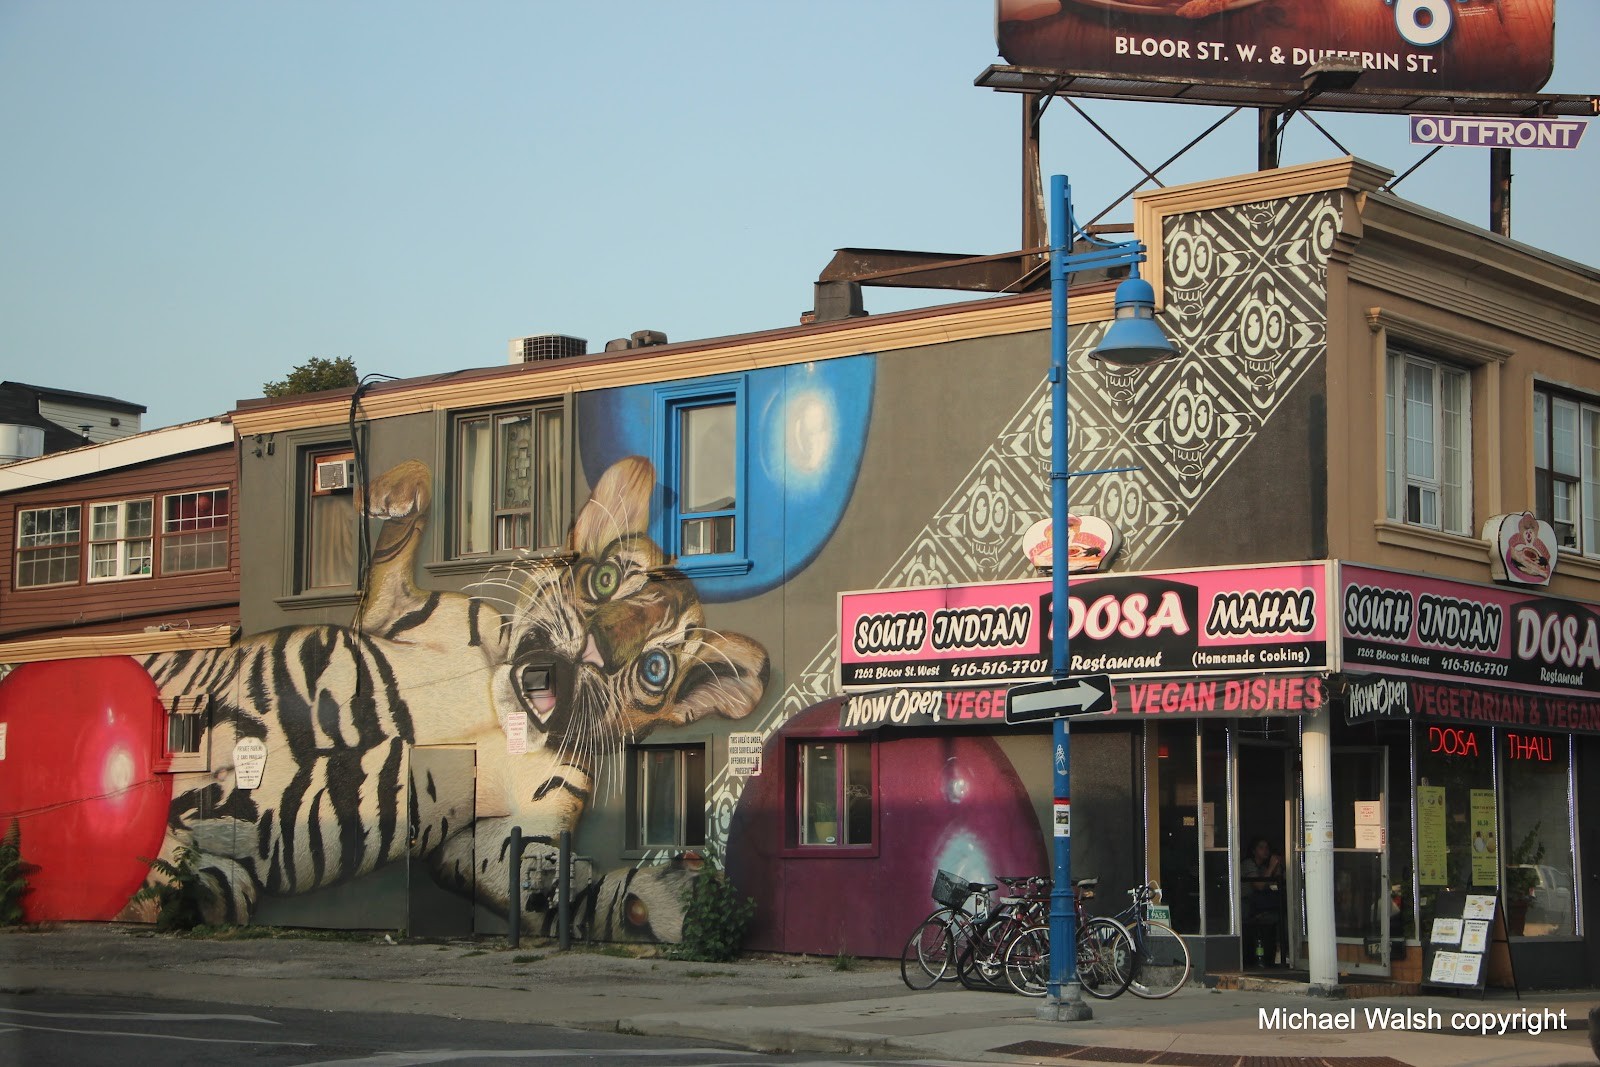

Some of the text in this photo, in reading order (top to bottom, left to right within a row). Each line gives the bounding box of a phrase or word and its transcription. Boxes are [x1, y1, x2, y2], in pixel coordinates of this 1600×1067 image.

[1115, 36, 1191, 59] BLOOR
[1197, 42, 1229, 61] ST.
[1236, 43, 1263, 63] W.
[1269, 46, 1286, 64] &
[1406, 54, 1438, 74] ST.
[1415, 118, 1579, 146] OUTFRONT
[855, 606, 1031, 654] SOUTH INDIAN
[1048, 591, 1314, 640] DOSA MAHAL
[1346, 587, 1501, 649] SOUTH INDIAN
[1517, 608, 1600, 670] DOSA
[854, 667, 874, 679] 1262
[876, 666, 903, 679] Bloor
[951, 659, 1049, 678] 416-516-7701
[1071, 651, 1162, 672] Restaurant
[1192, 647, 1311, 669] (Homemade Cooking)
[1357, 647, 1374, 659] 1262
[1376, 649, 1399, 662] Bloor
[1441, 657, 1509, 677] 416-516-7701
[1540, 667, 1584, 686] Restaurant
[890, 688, 943, 724] Open
[1129, 681, 1217, 714] VEGAN
[1224, 677, 1323, 711] DISHES
[1377, 677, 1410, 715] Open
[1411, 682, 1525, 724] VEGETARIAN
[1529, 699, 1540, 725] &
[1545, 700, 1600, 731] VEGAN
[729, 746, 762, 754] VIDEO SURVEILLANCE
[730, 736, 738, 744] THIS
[750, 736, 761, 744] UNDER
[1429, 727, 1478, 757] DOSA
[1508, 734, 1552, 761] THALI
[747, 756, 755, 764] WILL
